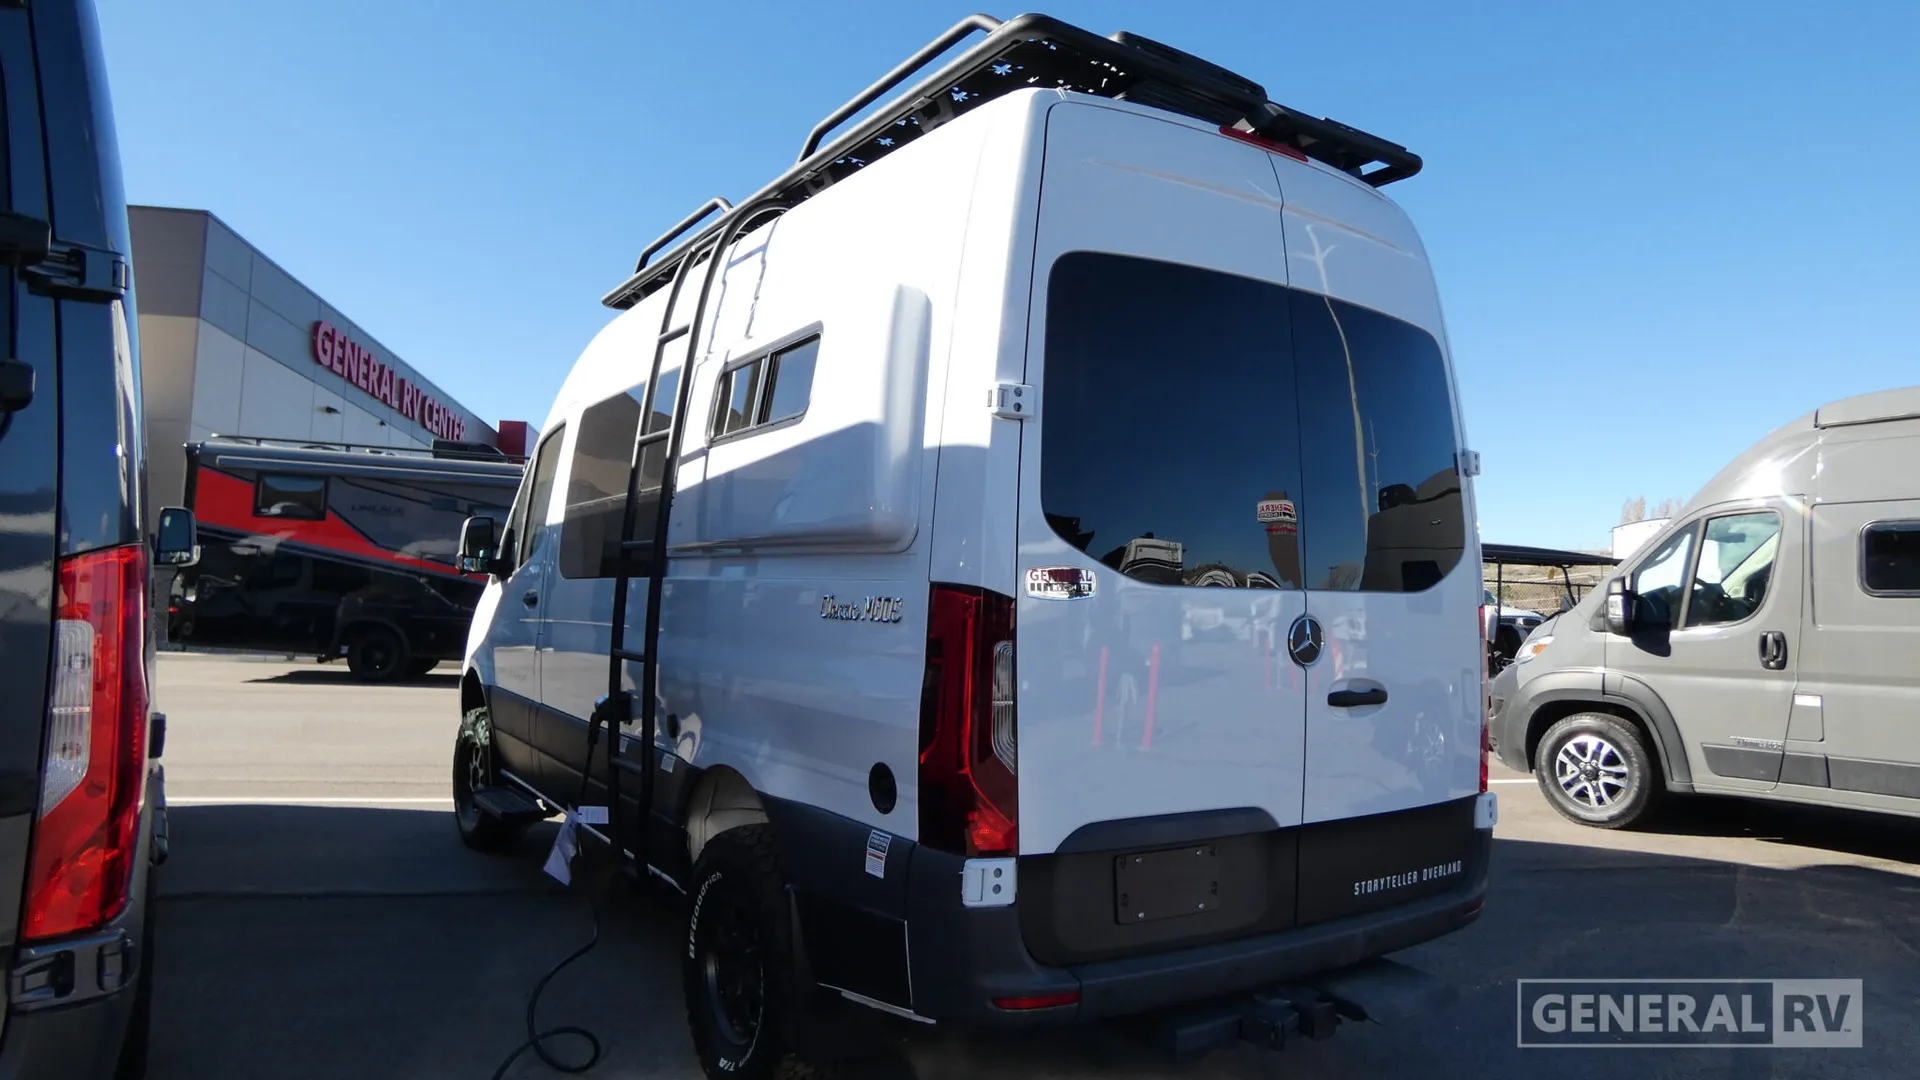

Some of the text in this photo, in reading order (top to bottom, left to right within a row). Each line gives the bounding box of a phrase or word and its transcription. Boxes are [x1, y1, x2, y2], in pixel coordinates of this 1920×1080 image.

[313, 320, 466, 441] GENERAL RV CENTER
[1030, 569, 1093, 582] GENAL
[1354, 860, 1462, 896] STORYTELLER OVERLAND
